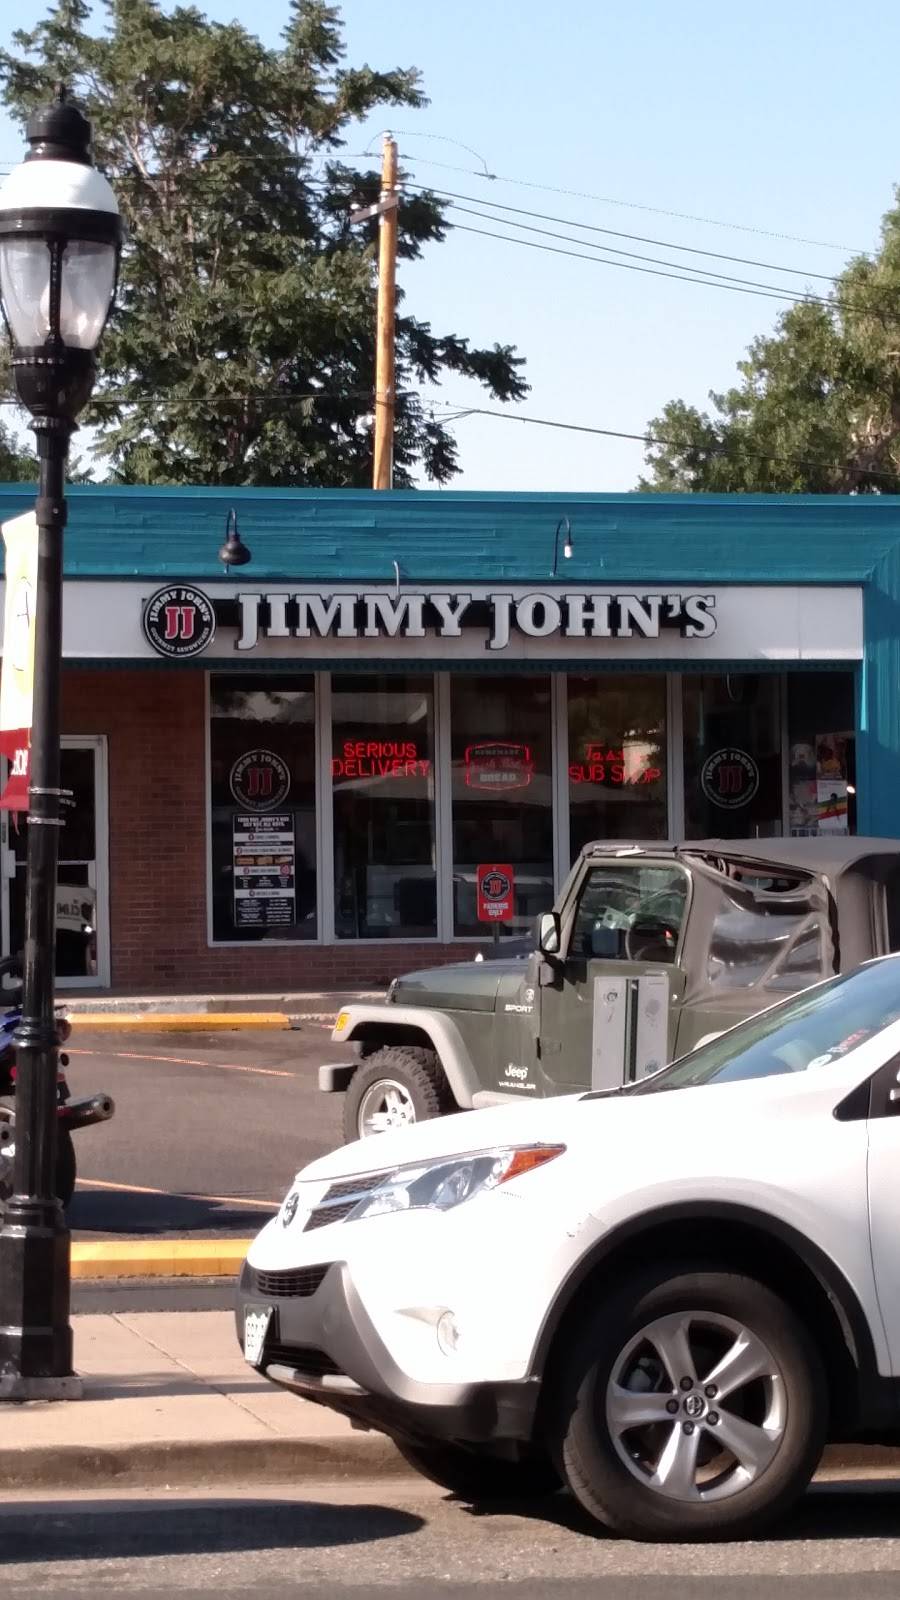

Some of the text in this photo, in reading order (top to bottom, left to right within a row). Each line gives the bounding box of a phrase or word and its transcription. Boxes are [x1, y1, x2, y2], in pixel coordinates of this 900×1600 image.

[149, 590, 211, 623] JIMMY JOHN'S
[236, 592, 718, 650] JIMMY JOHN'S
[343, 742, 417, 759] SERIOUS
[330, 758, 431, 778] DELIVERY
[568, 763, 606, 784] SUB
[505, 1004, 533, 1012] SPORT
[505, 1062, 528, 1080] Jeep
